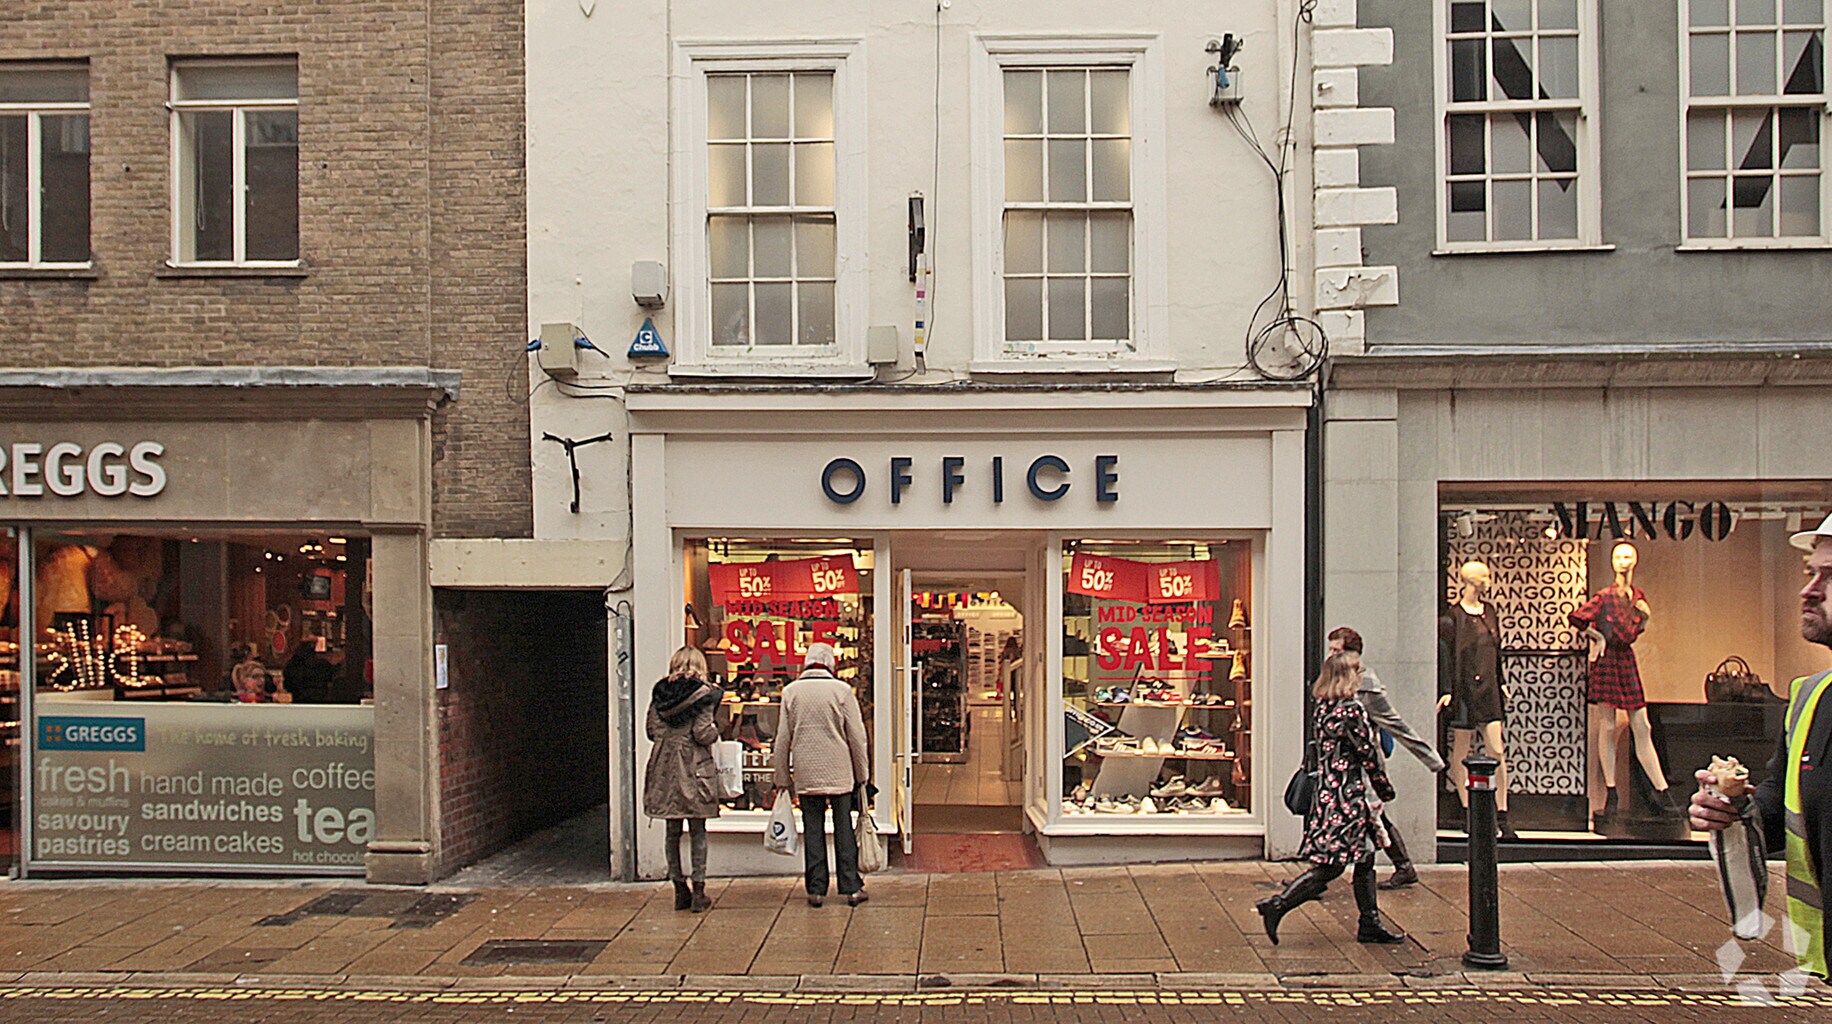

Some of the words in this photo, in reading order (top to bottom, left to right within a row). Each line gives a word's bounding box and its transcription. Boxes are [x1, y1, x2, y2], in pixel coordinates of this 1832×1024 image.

[0, 441, 166, 496] EGGS
[821, 455, 1119, 504] OFFICE
[1553, 501, 1732, 542] MANGO
[739, 576, 771, 598] 50%
[811, 569, 845, 592] 50%
[1081, 568, 1114, 591] 50%
[1159, 576, 1192, 598] 50%
[726, 600, 764, 616] MID
[768, 600, 839, 618] SEASON
[1098, 606, 1137, 624] MID
[1141, 606, 1214, 624] SEASON
[725, 620, 839, 665] SALE
[1097, 626, 1213, 671] SALE
[65, 725, 137, 742] GREGGS
[196, 728, 236, 745] home
[242, 727, 260, 745] of
[264, 724, 311, 746] fresh
[315, 728, 368, 754] baking
[38, 757, 130, 793] fresh
[140, 770, 203, 795] hand
[211, 772, 284, 797] made
[292, 762, 375, 790] coffee
[141, 799, 284, 823] sandwiches
[293, 798, 376, 844] tea
[38, 812, 130, 836] savoury
[38, 833, 130, 858] pastries
[141, 833, 210, 852] cream
[214, 831, 284, 854] cakes
[293, 849, 313, 863] hot
